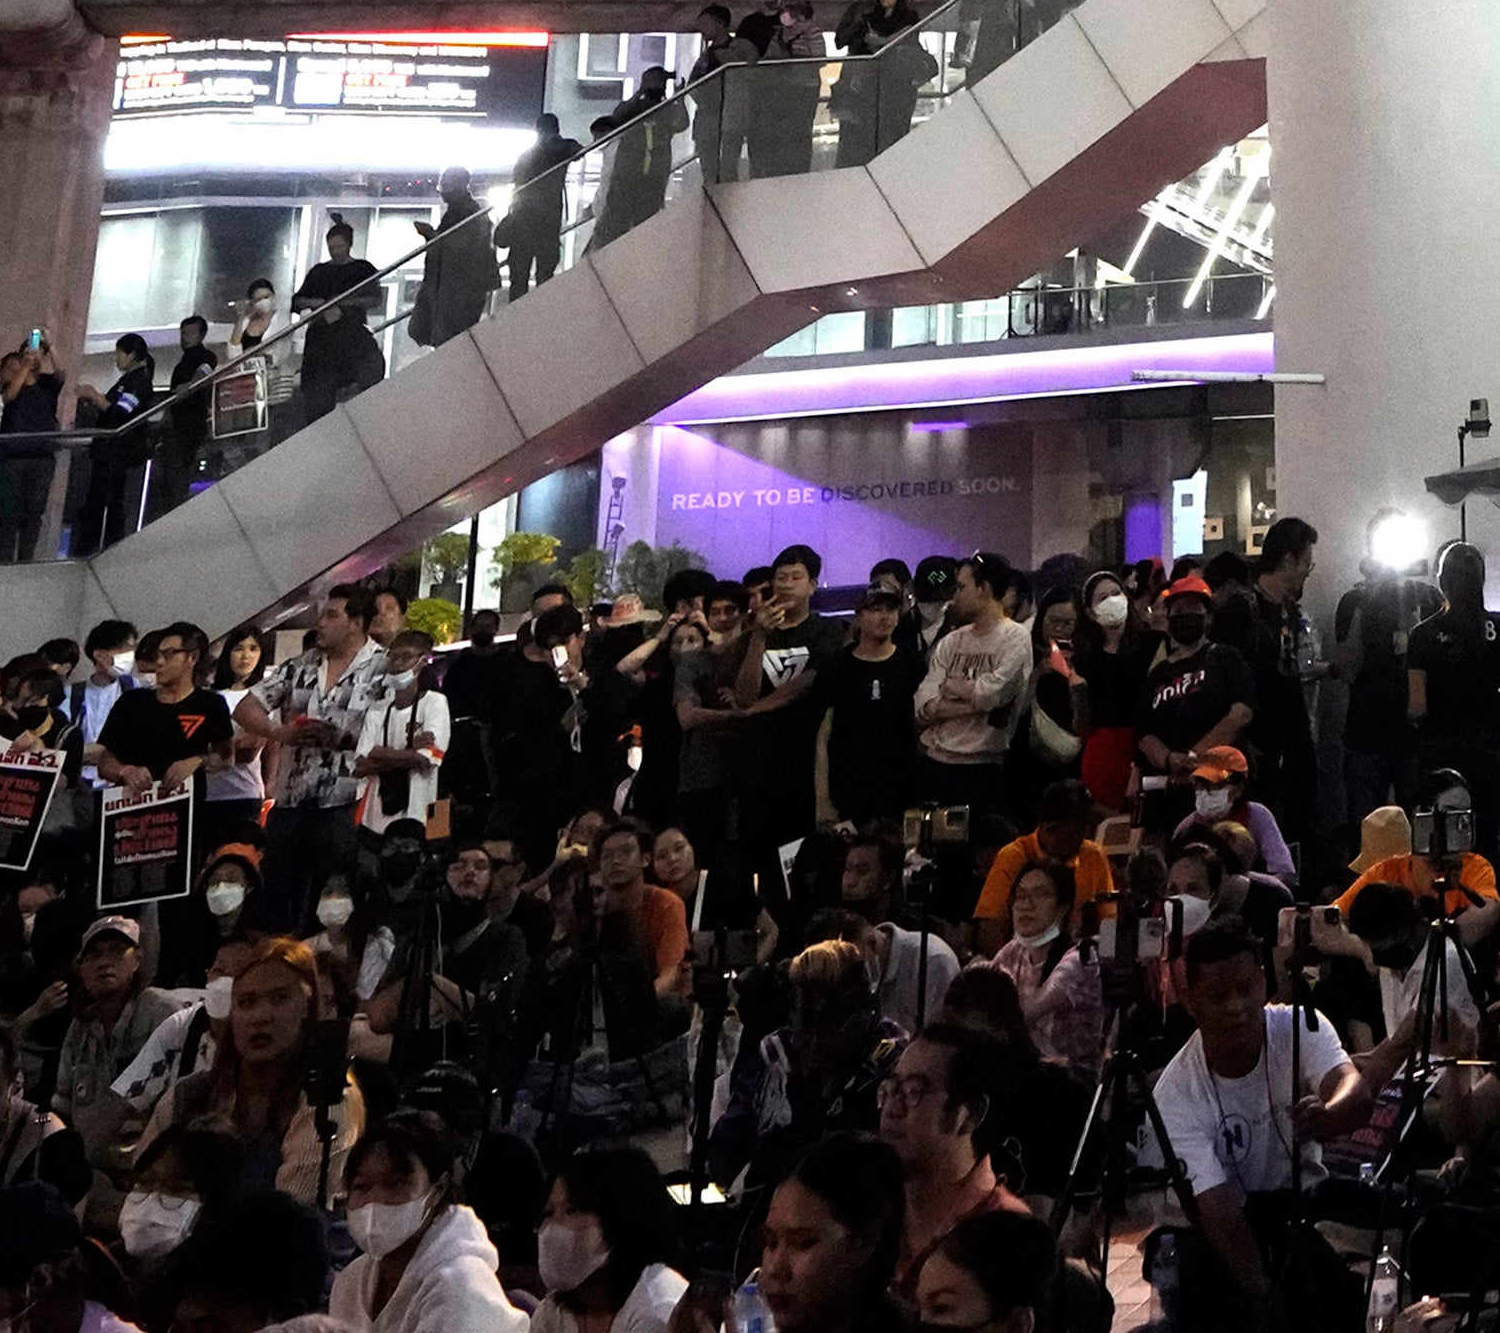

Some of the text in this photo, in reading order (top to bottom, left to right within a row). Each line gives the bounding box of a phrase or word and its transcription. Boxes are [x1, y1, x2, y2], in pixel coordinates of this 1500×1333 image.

[672, 491, 746, 510] READY
[753, 489, 781, 506] TO
[787, 487, 815, 505] BE
[821, 481, 952, 503] DISCOVERED
